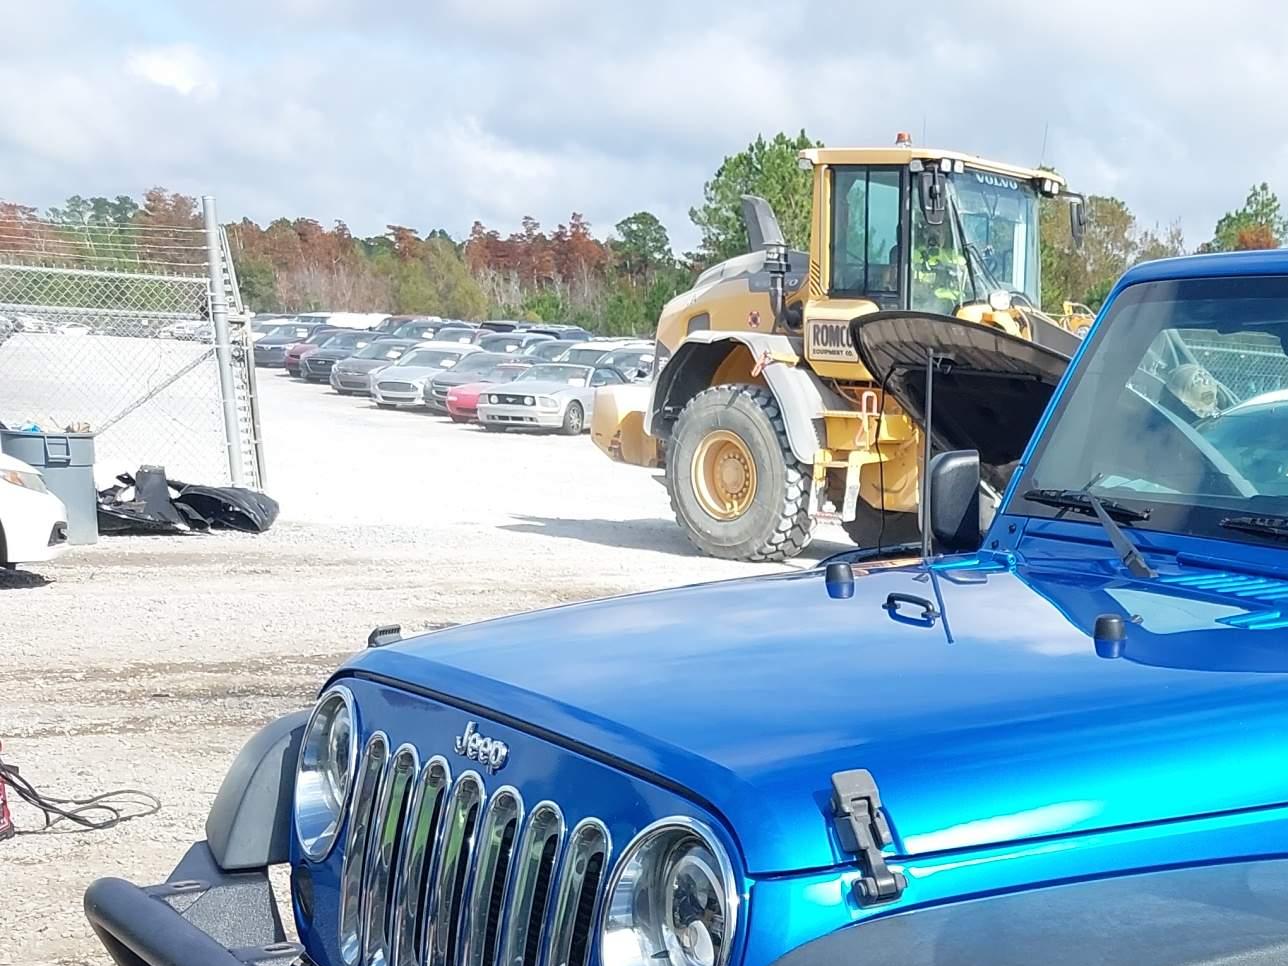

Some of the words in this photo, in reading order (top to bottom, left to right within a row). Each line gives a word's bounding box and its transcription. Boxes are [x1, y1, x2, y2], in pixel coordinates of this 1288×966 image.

[975, 173, 1018, 190] VOLVO
[813, 324, 853, 348] ROMCO
[454, 720, 508, 775] Jeep
